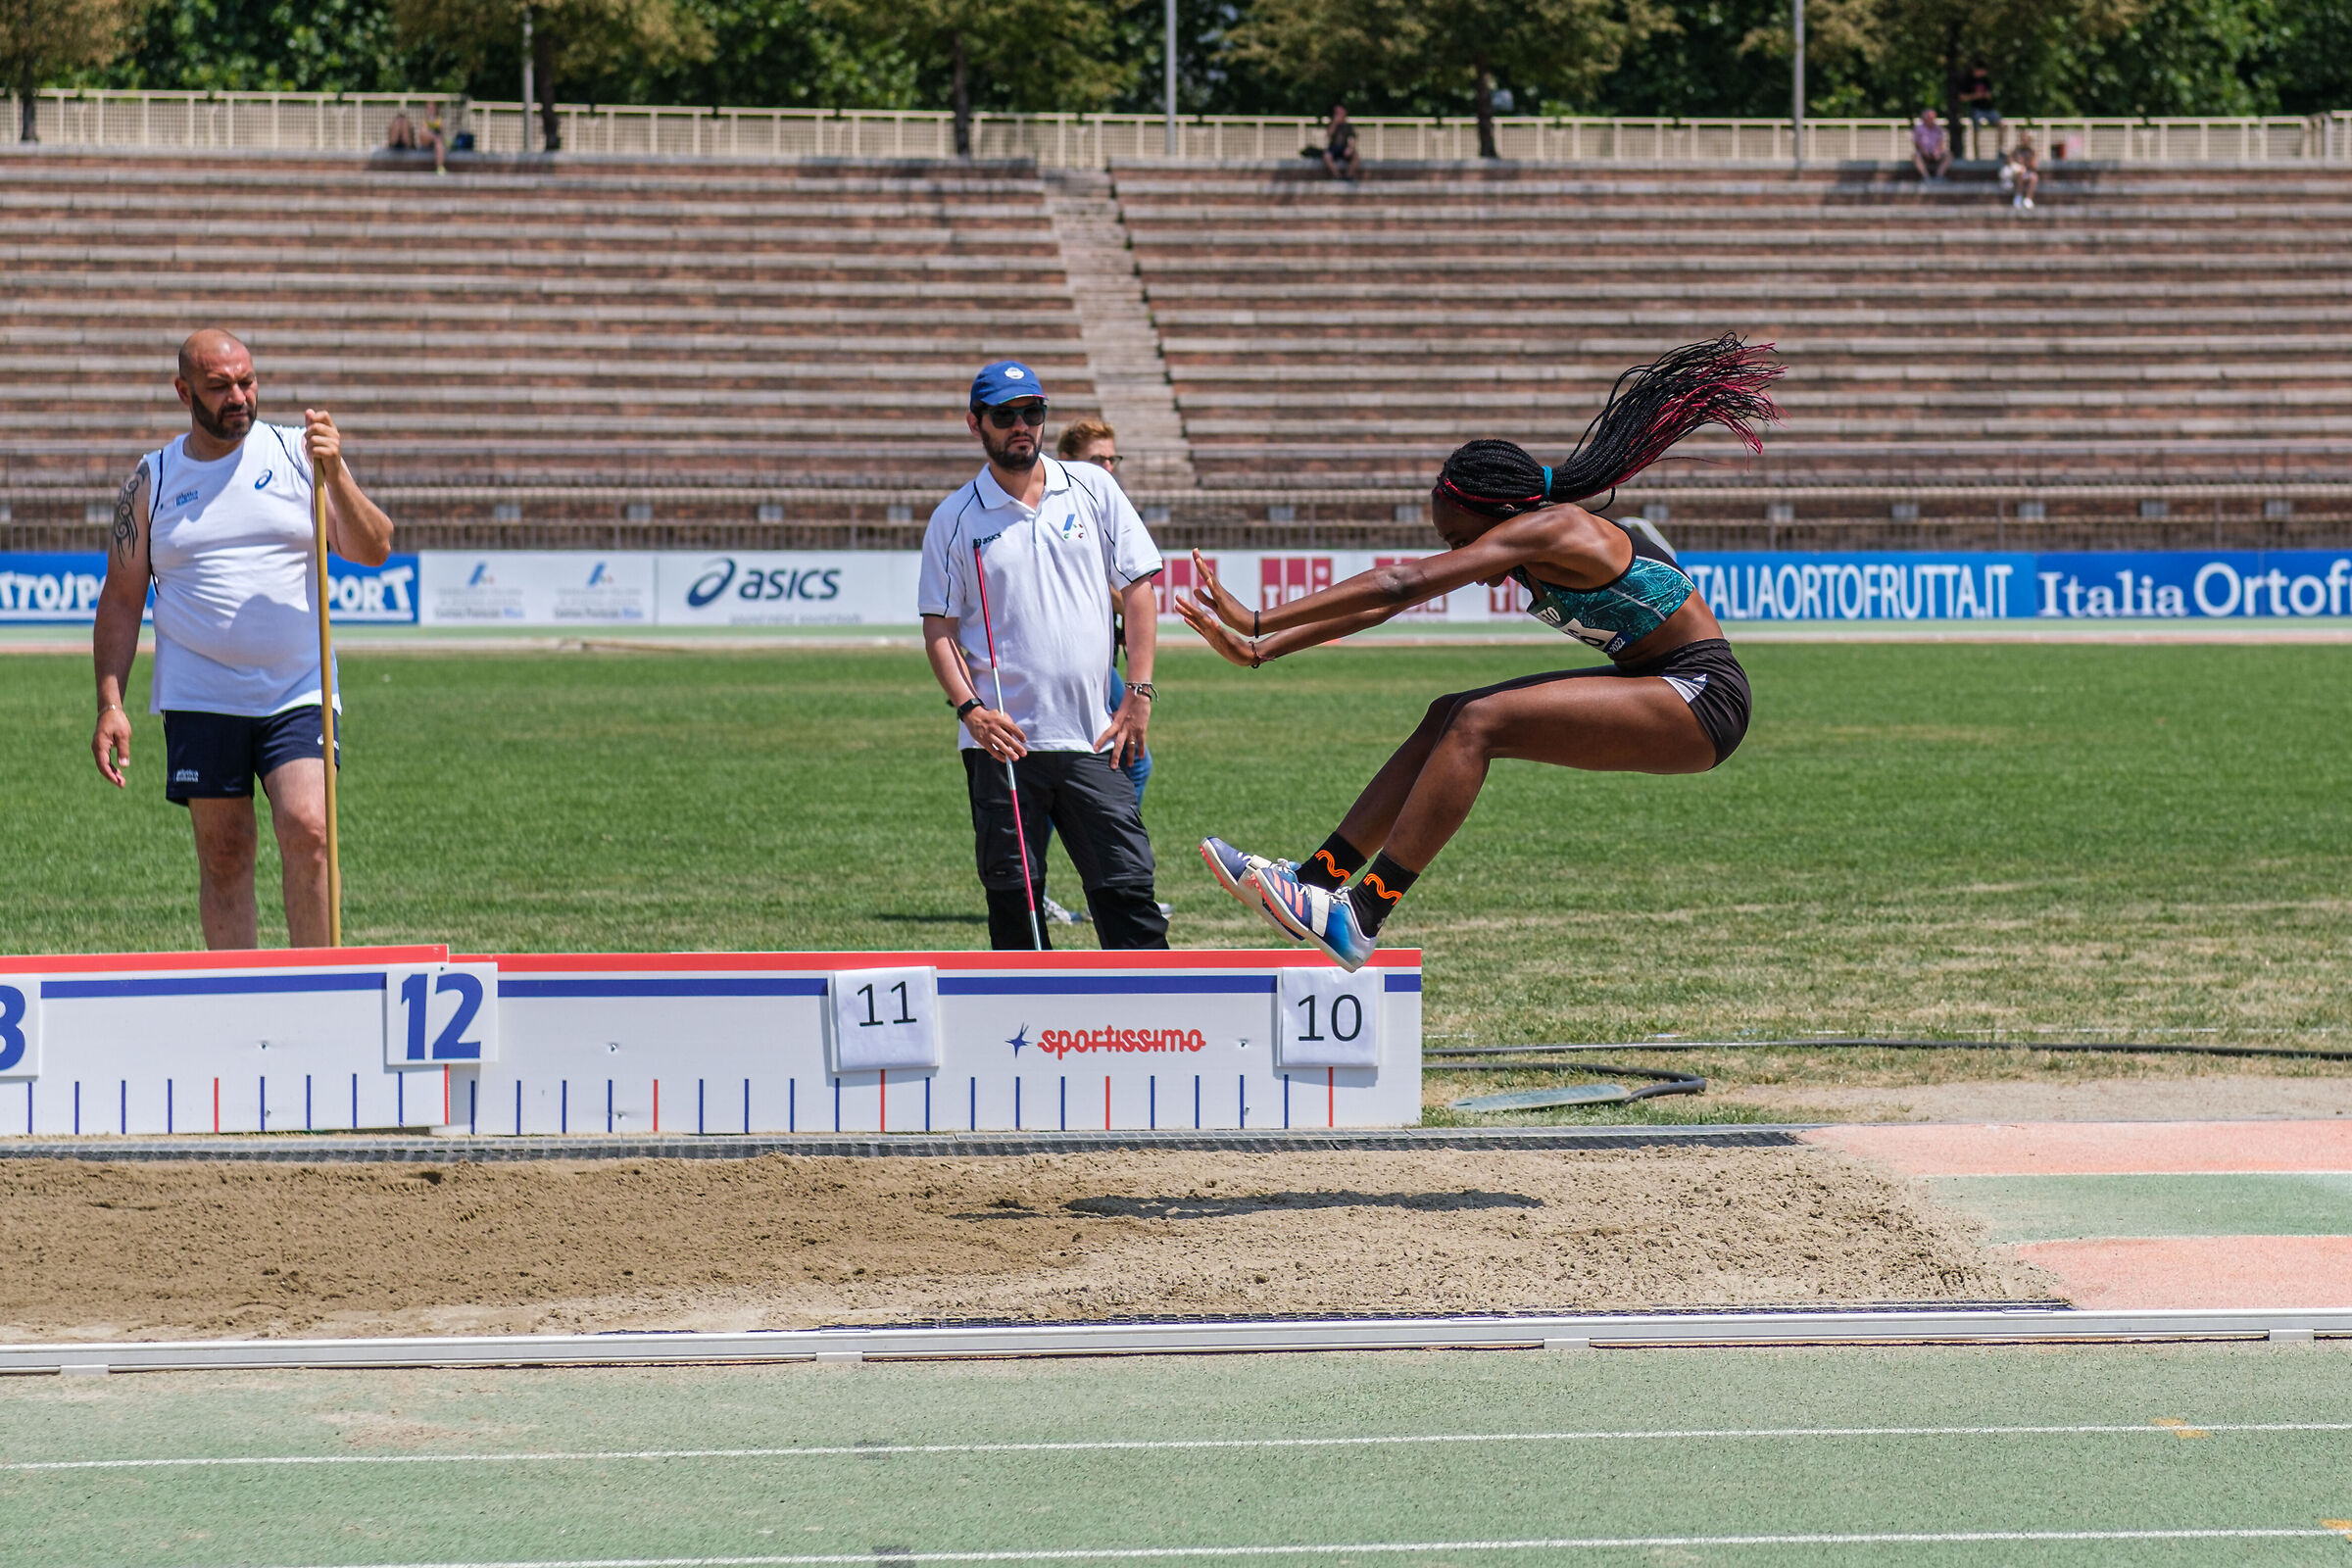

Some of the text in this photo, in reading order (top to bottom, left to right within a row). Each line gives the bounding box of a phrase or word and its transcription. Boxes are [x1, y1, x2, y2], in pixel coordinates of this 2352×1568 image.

[739, 568, 842, 601] asics
[1685, 564, 2014, 619] TALIAORTOFRUTTA.IT
[2037, 558, 2352, 617] Italia Ortof
[401, 973, 484, 1060] 12
[857, 980, 918, 1027] 11
[1298, 994, 1362, 1042] 10
[1037, 1024, 1206, 1060] sportissimo
